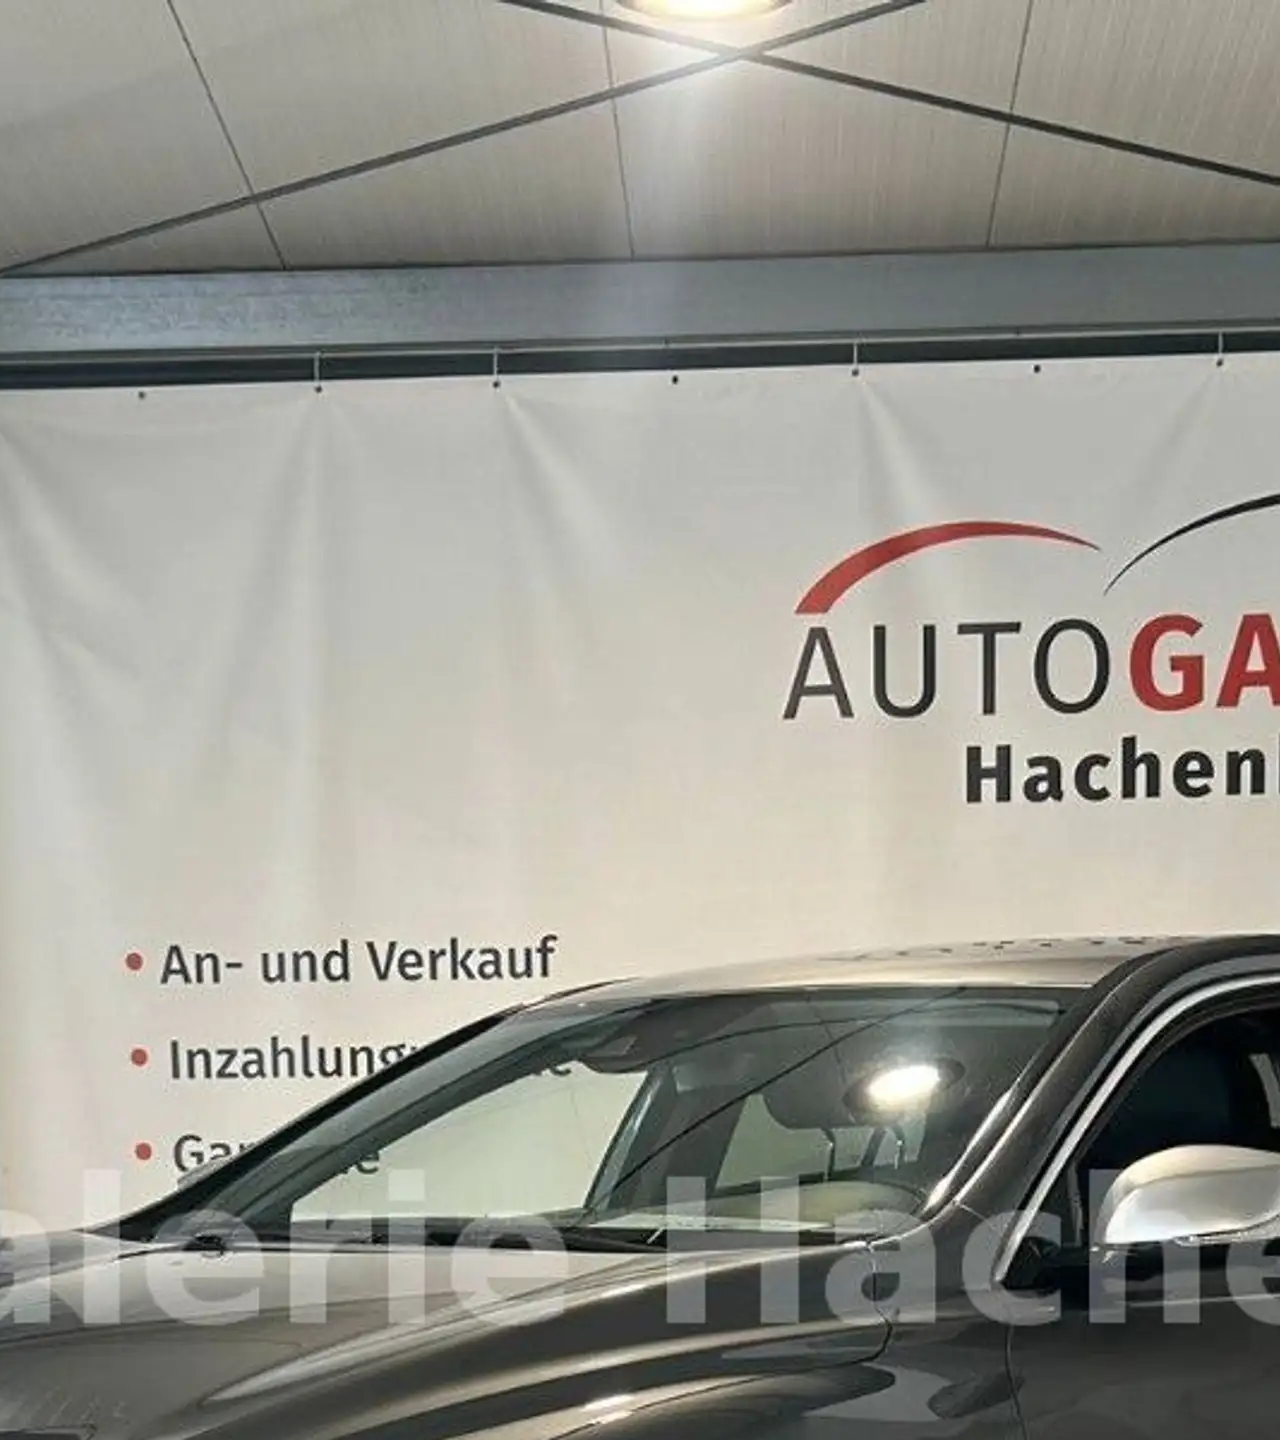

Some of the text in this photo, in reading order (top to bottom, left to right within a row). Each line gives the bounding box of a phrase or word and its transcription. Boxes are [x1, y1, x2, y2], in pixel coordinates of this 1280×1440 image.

[160, 935, 558, 984] An- und Verkauf
